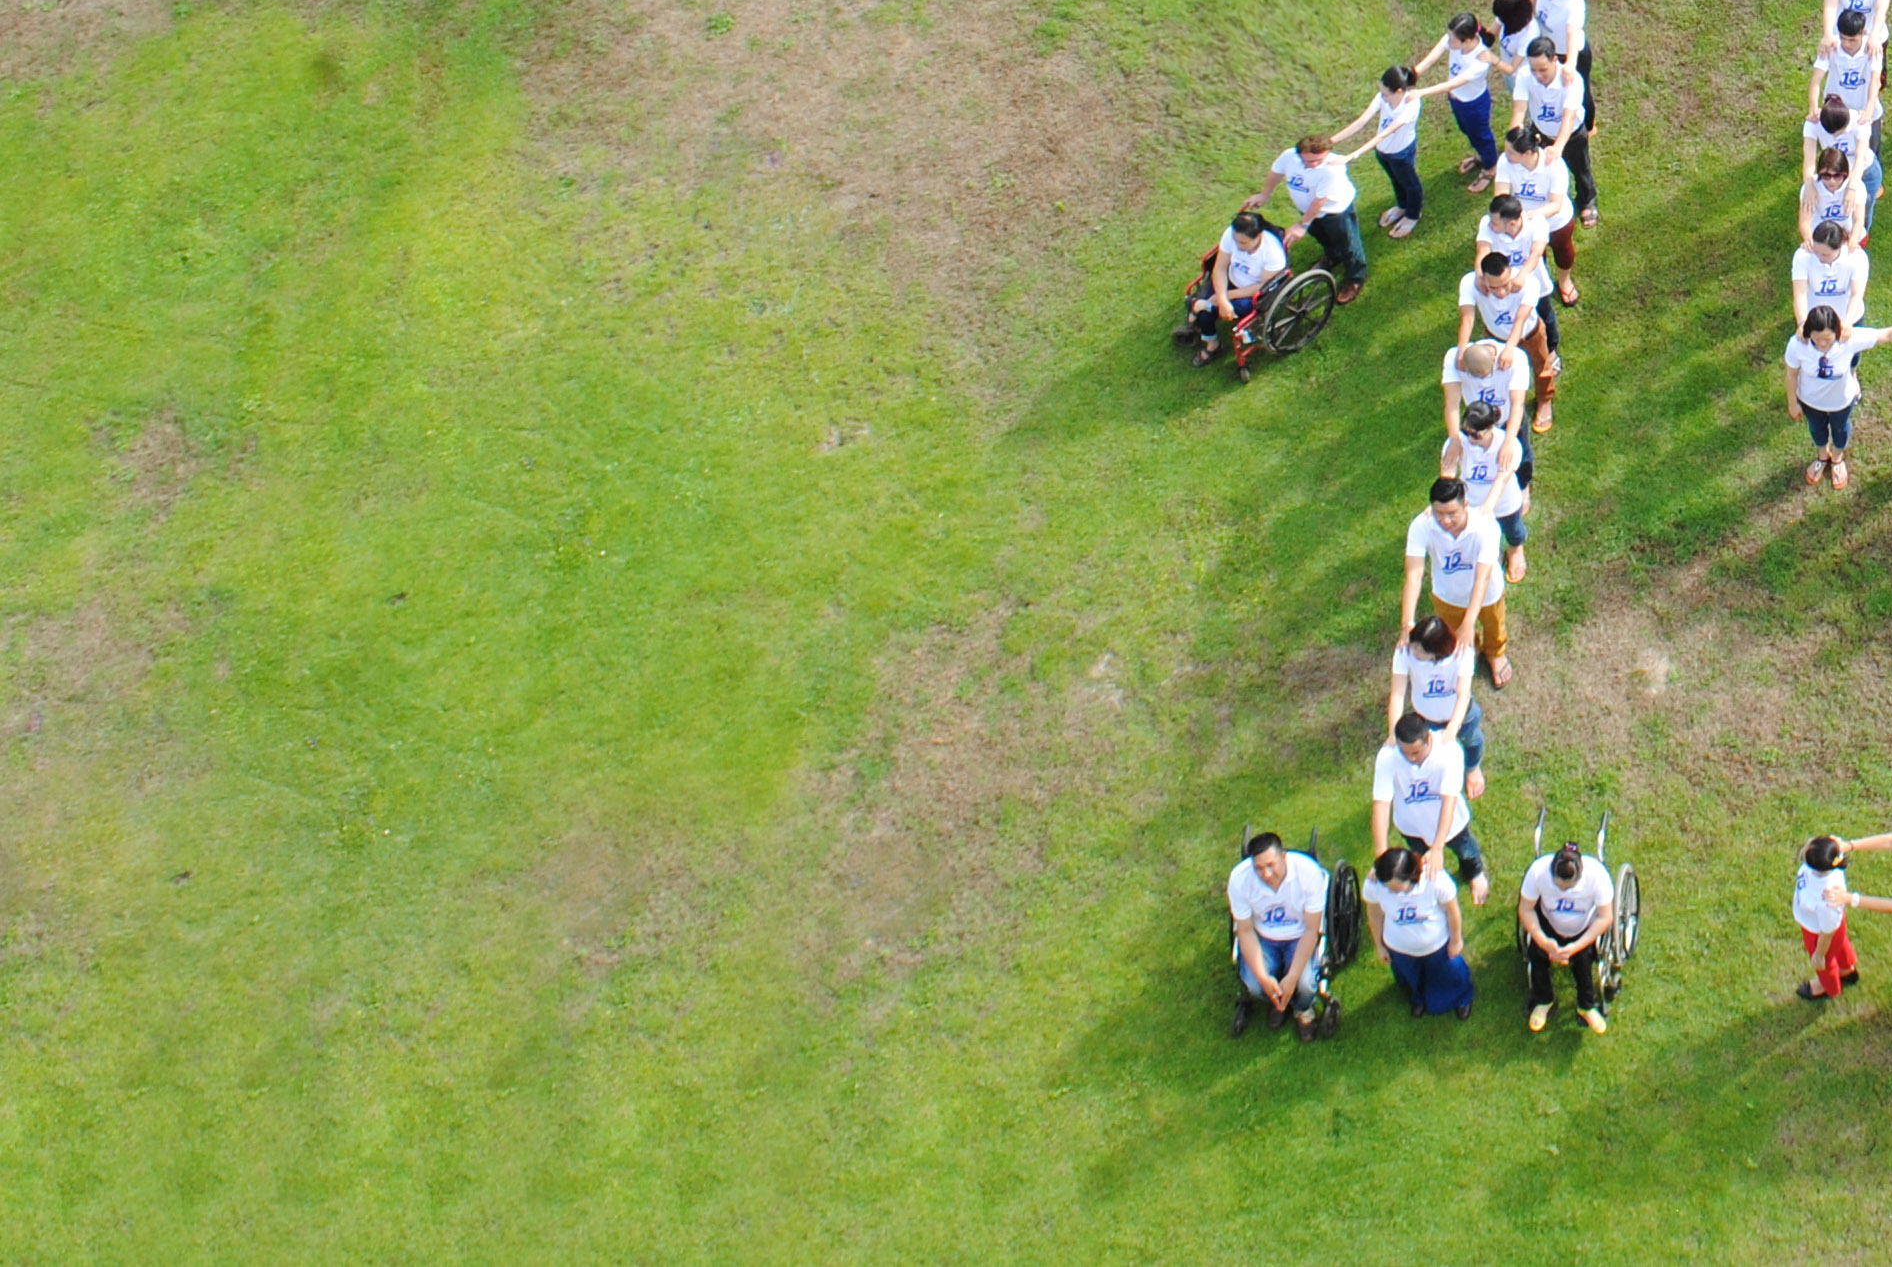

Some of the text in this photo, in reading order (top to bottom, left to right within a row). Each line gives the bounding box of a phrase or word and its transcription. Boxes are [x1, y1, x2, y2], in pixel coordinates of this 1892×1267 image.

[1843, 71, 1859, 86] 15
[1520, 183, 1536, 195] 15
[1825, 204, 1841, 218] 15
[1820, 280, 1837, 293] 15
[1479, 389, 1494, 401] 15
[1472, 466, 1488, 479] 15
[1444, 552, 1461, 568] 15
[1427, 679, 1445, 694] 15
[1410, 781, 1429, 798] 15
[1556, 898, 1575, 911] 15
[1266, 907, 1286, 922] 15
[1398, 907, 1417, 920] 15
